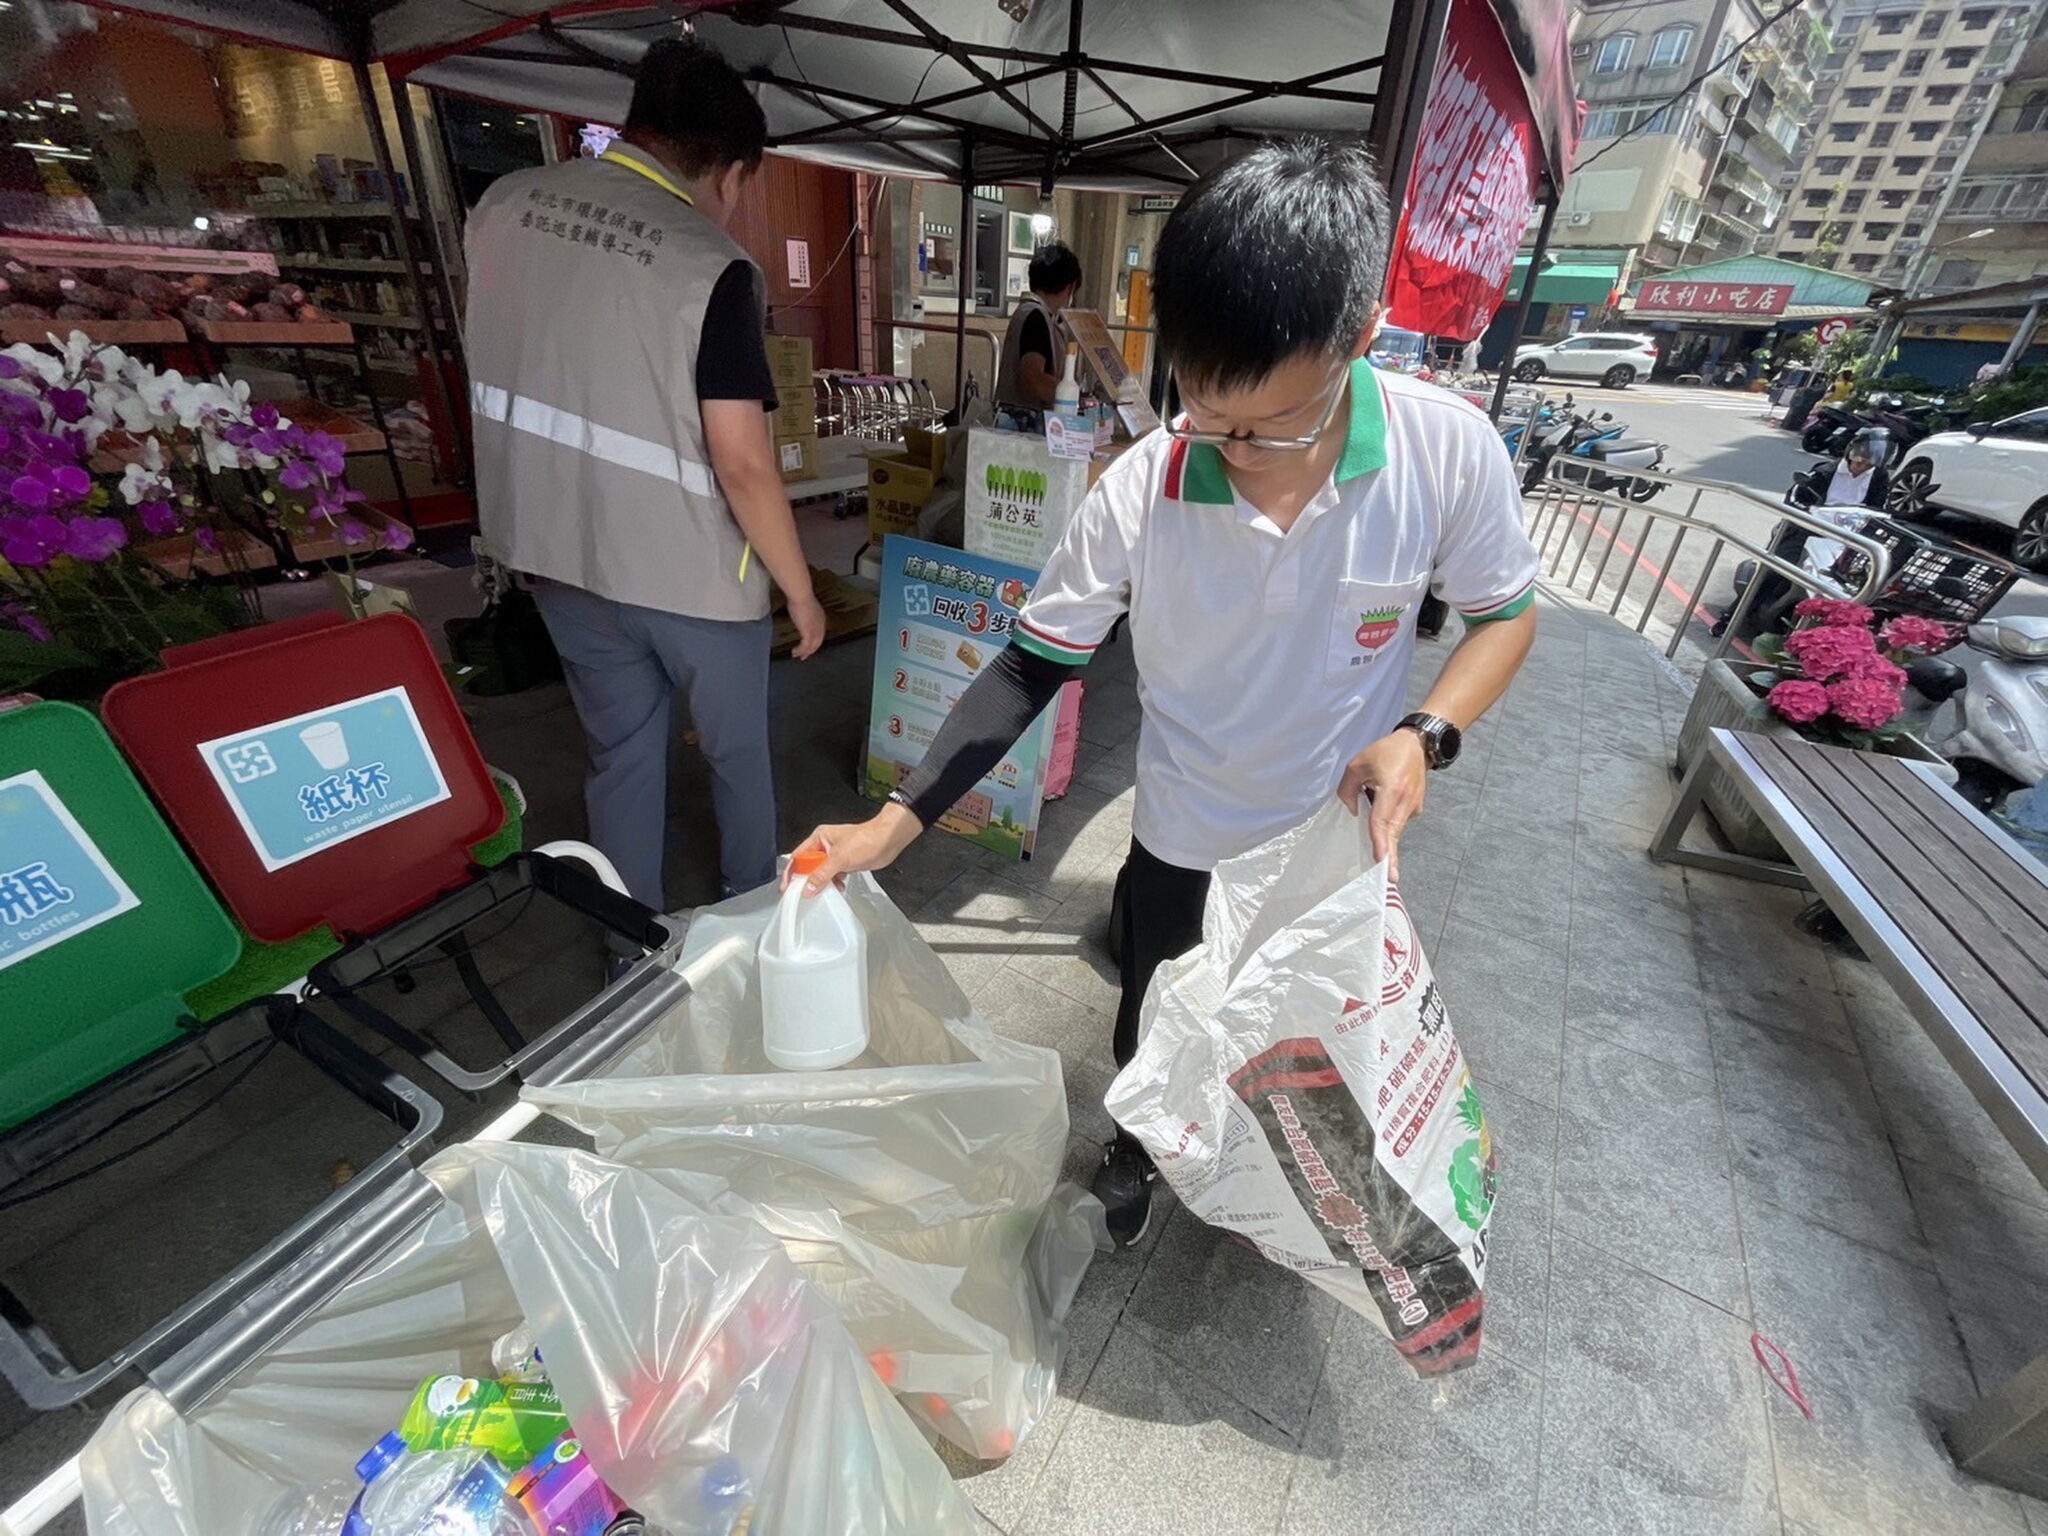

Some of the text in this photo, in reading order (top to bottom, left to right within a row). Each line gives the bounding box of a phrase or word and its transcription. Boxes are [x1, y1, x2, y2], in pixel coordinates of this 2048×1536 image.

[520, 210, 655, 268] 委託巡查輔導工作
[1649, 285, 1778, 310] 欣利小吃店
[986, 502, 1040, 529] 蒲公英
[904, 555, 997, 600] 廢農藥容器
[899, 627, 911, 652] 1
[893, 668, 909, 693] 2
[888, 714, 904, 738] 3
[298, 762, 390, 823] 紙杯
[303, 794, 413, 843] waste paper utensil
[18, 910, 80, 941] bottles
